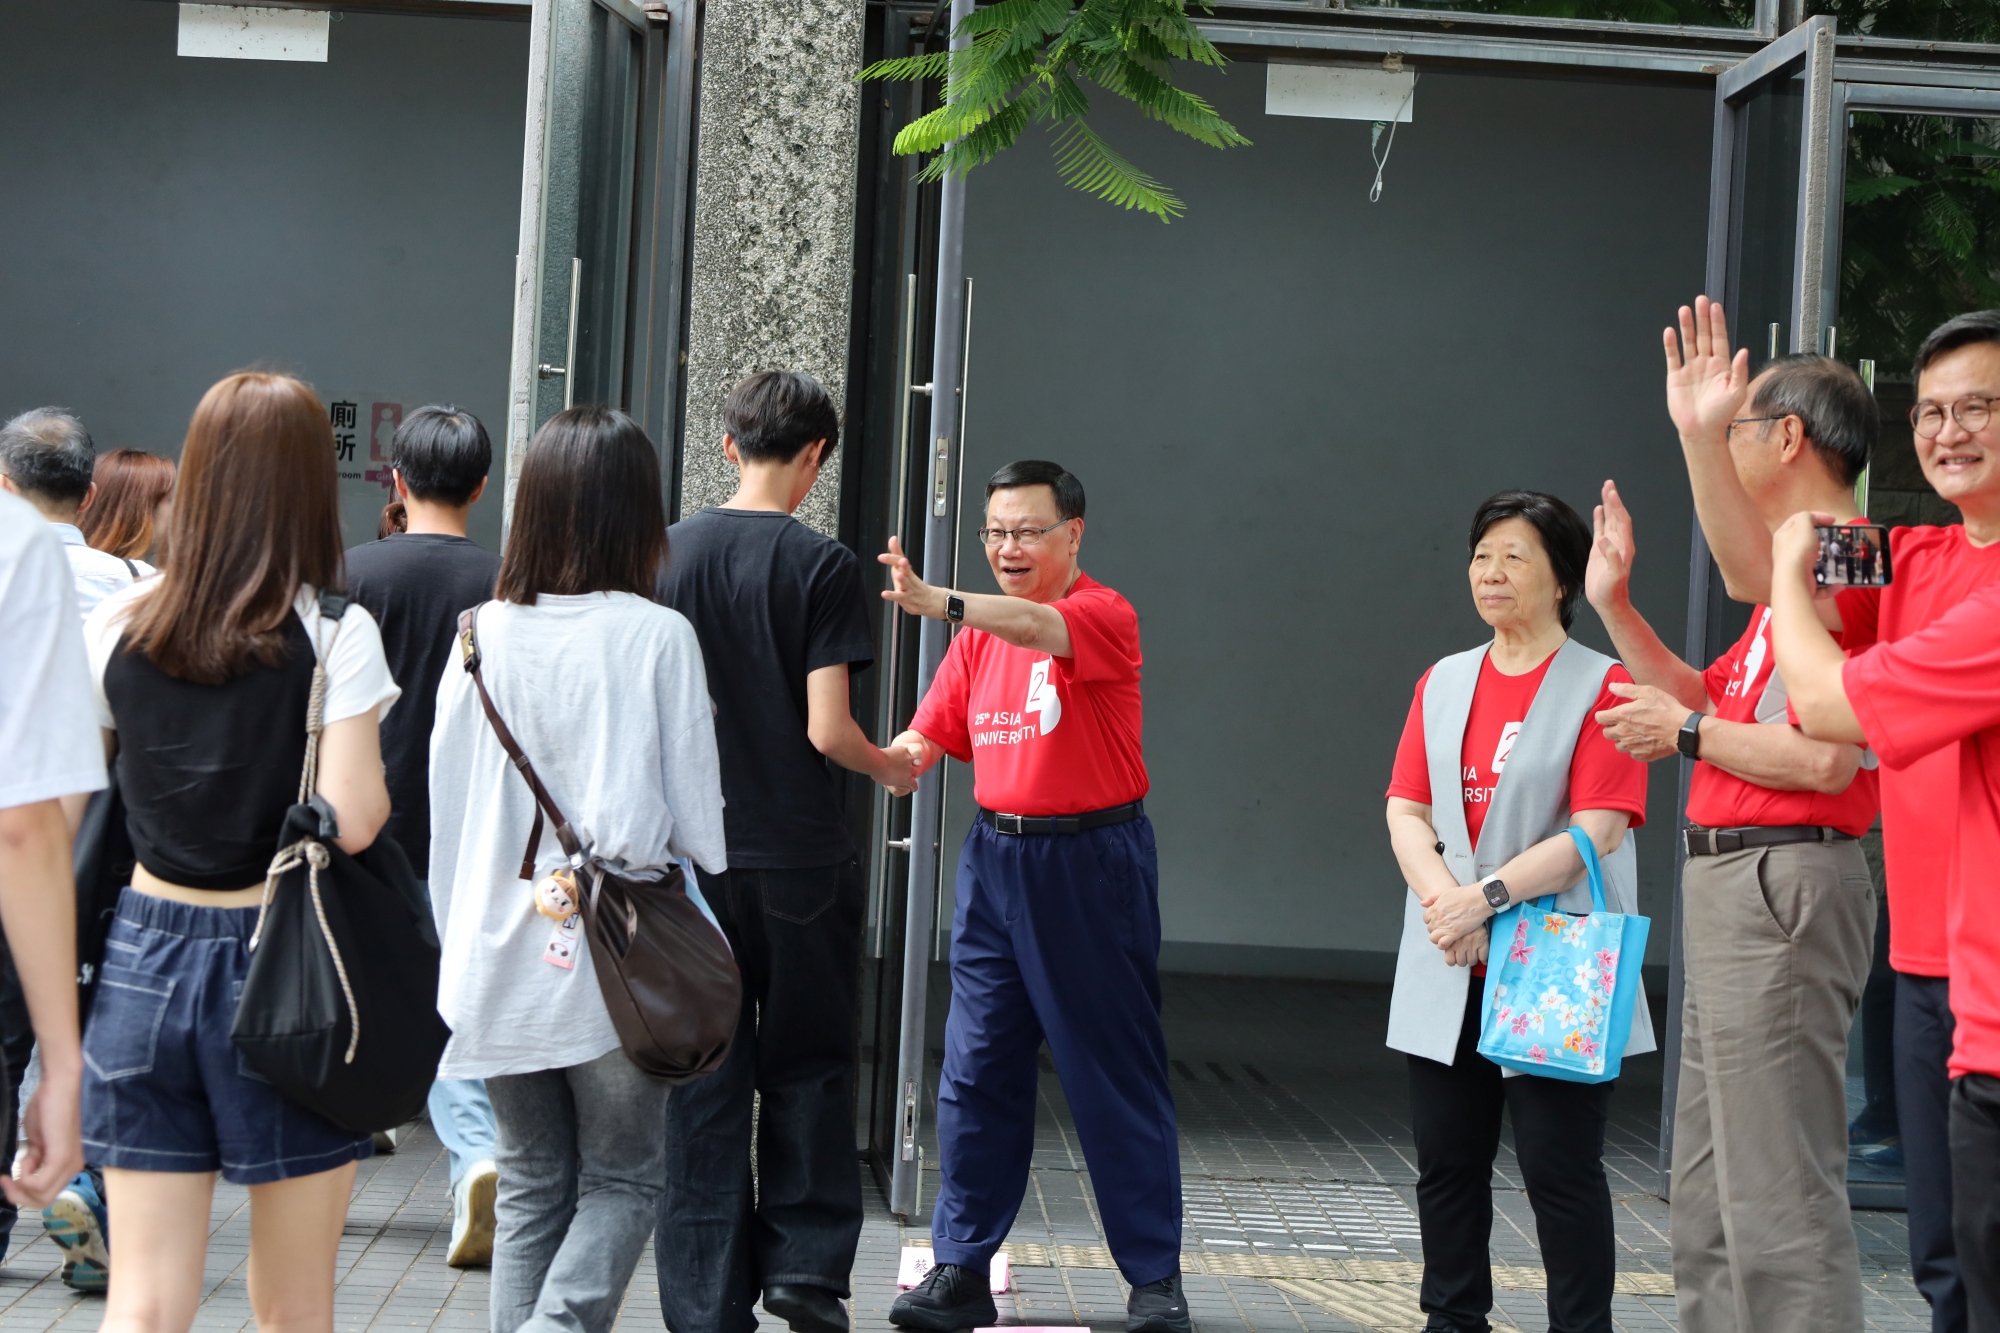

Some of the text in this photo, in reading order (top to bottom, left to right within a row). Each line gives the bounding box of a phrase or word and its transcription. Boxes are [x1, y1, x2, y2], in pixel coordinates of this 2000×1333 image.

[331, 400, 357, 461] 廁所
[974, 711, 1021, 726] 25th ASIA
[974, 724, 1036, 747] UNIVERSITY
[1463, 766, 1477, 780] IA
[1464, 787, 1496, 802] RSIT
